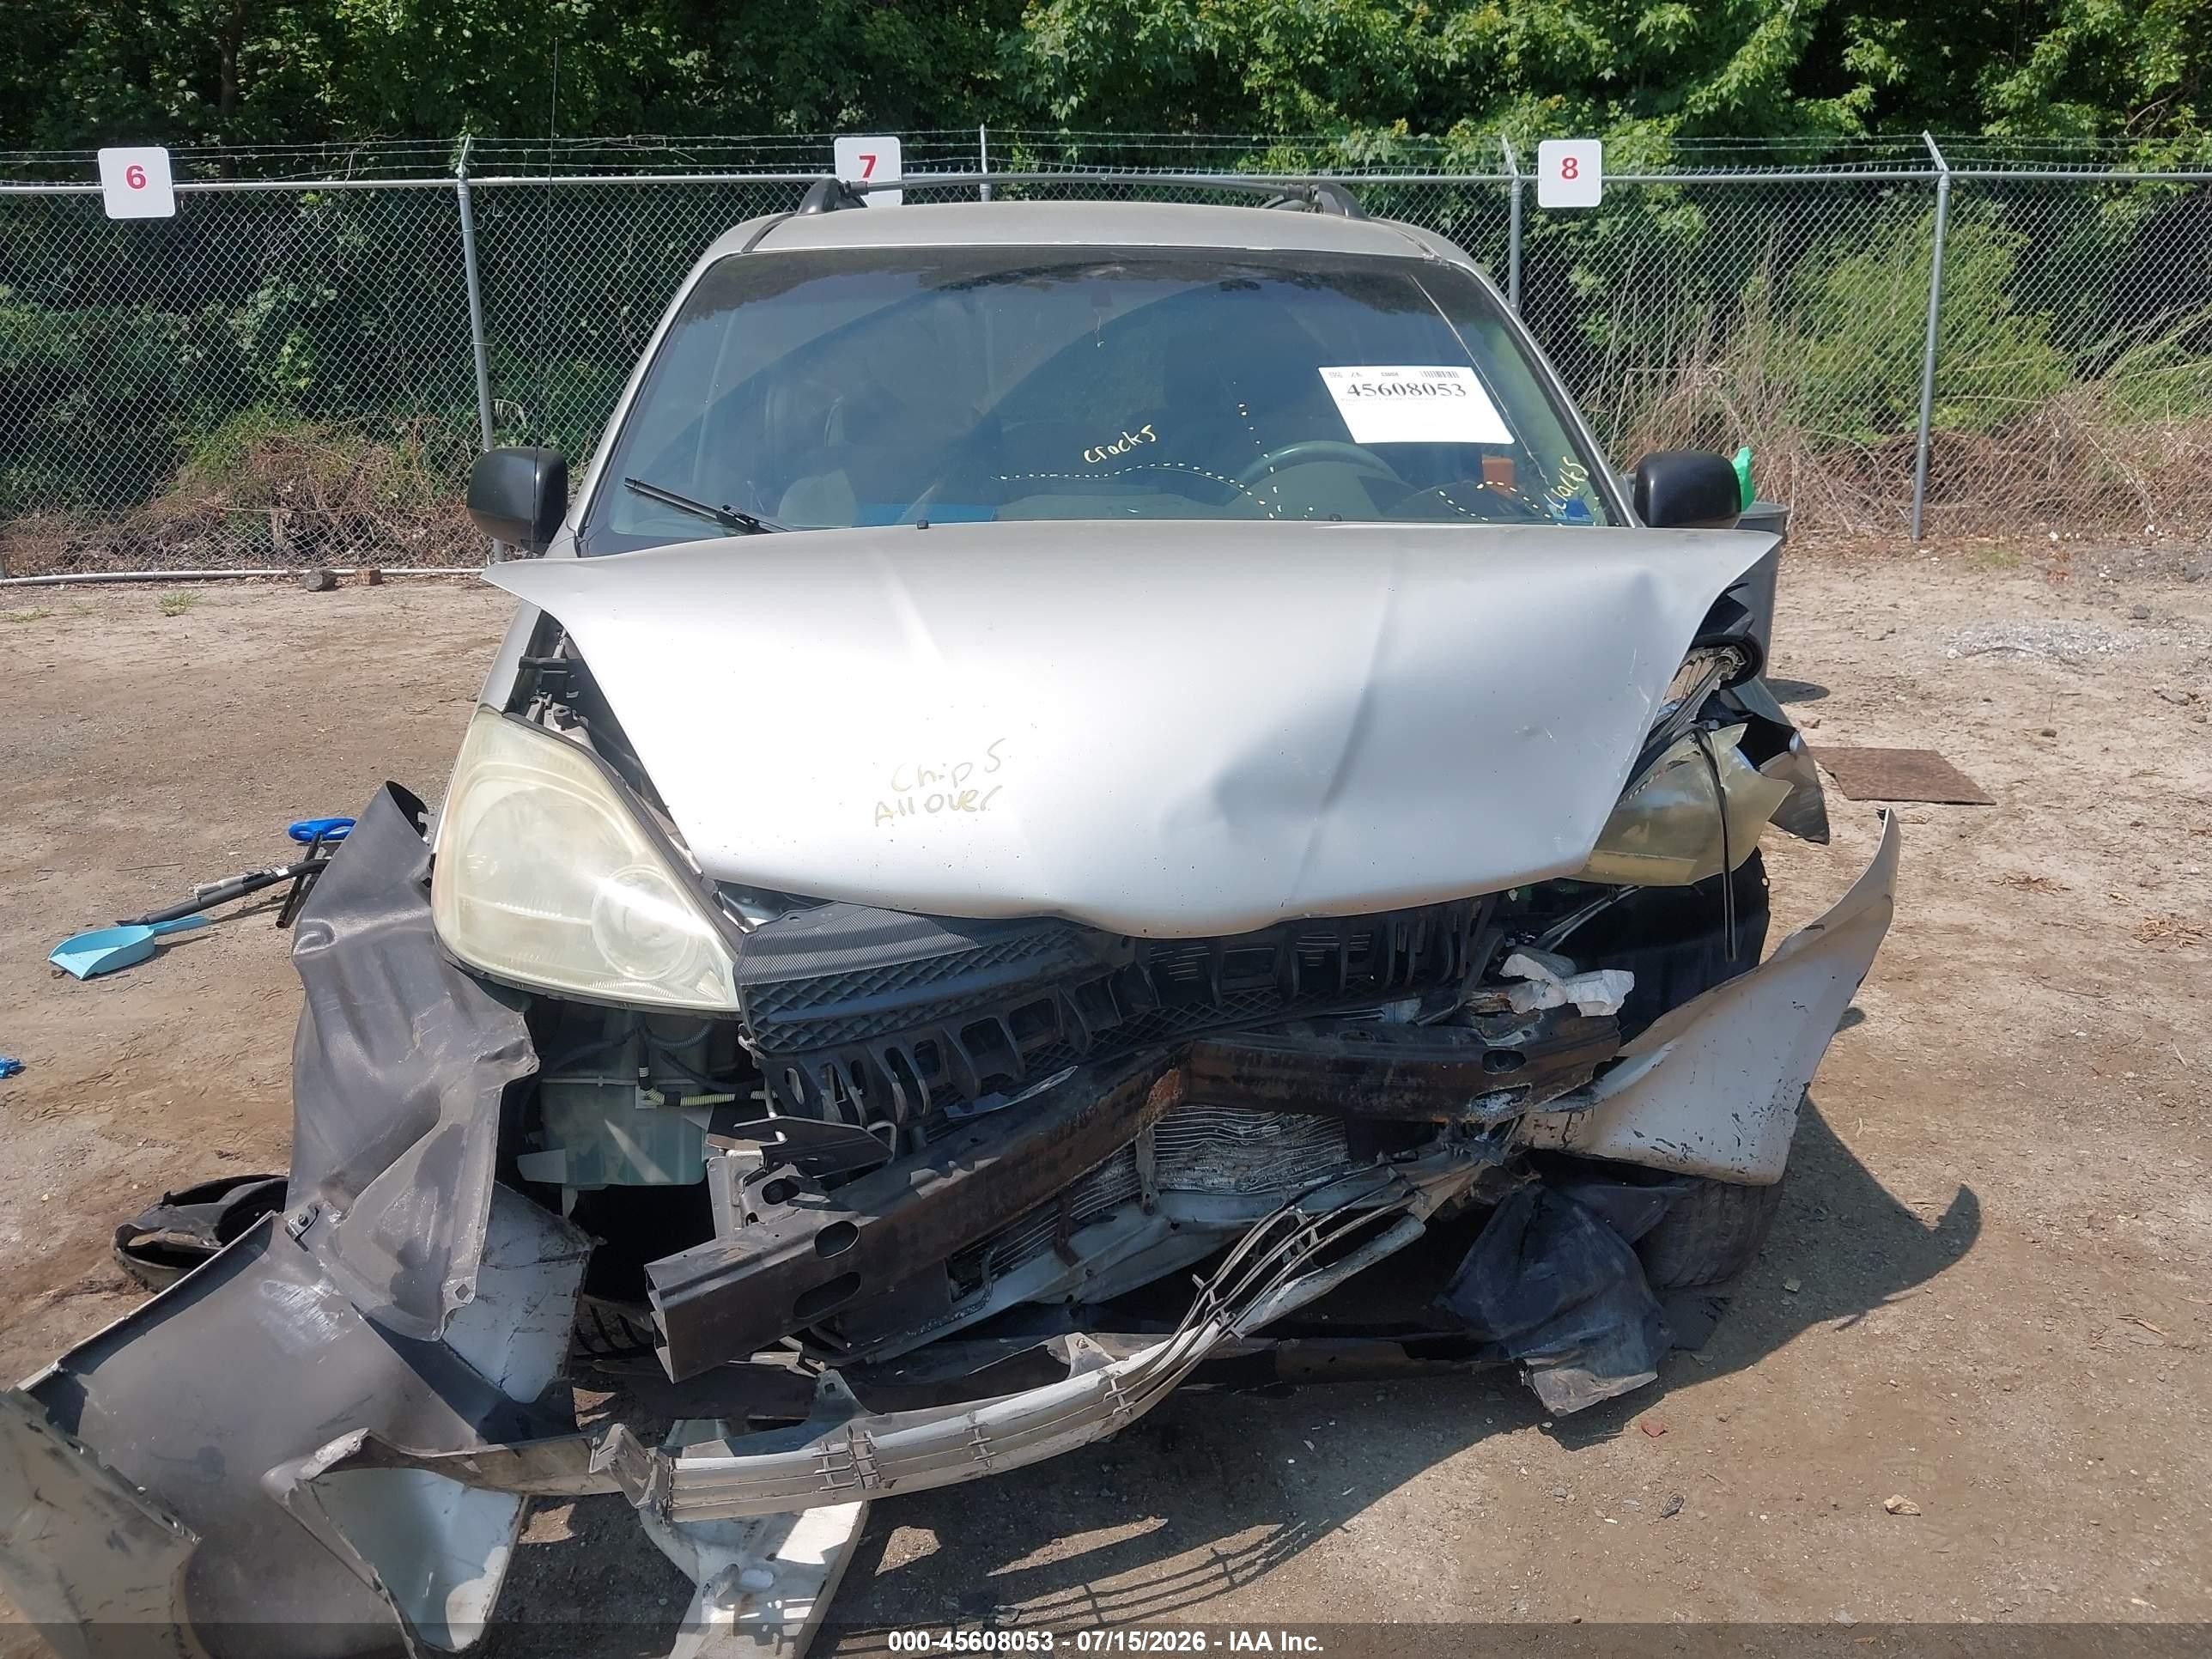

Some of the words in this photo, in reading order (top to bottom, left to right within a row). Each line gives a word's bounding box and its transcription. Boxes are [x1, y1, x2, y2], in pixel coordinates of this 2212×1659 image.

[125, 165, 146, 189] 6
[859, 155, 877, 178] 7
[1561, 157, 1578, 179] 8
[1346, 382, 1467, 398] 45608053
